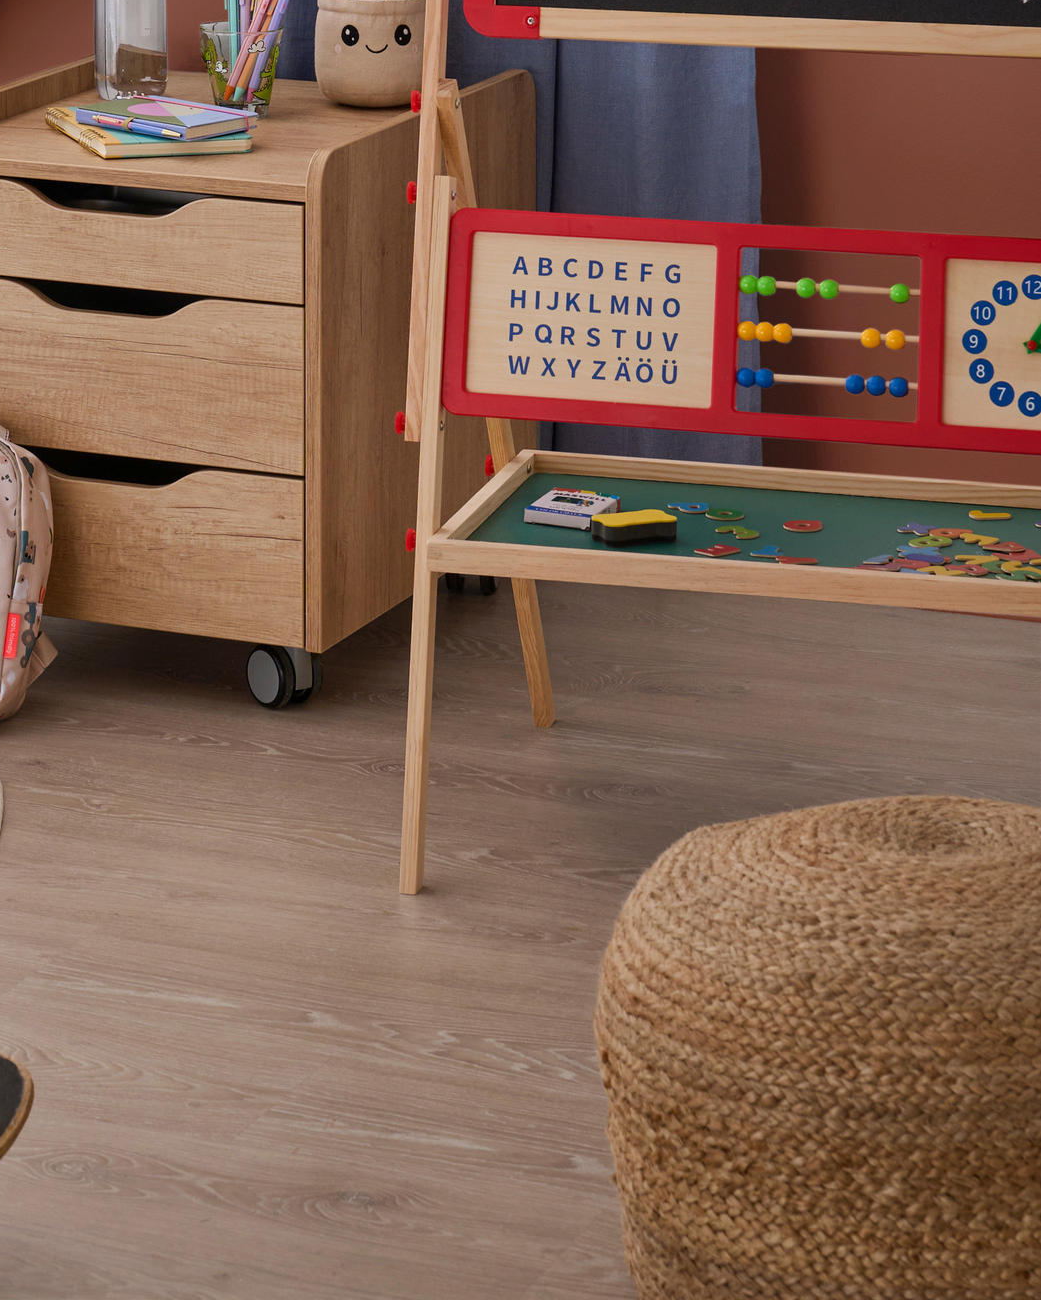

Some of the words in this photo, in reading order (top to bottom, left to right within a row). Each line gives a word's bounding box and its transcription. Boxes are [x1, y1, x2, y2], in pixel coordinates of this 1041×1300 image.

[996, 286, 1013, 300] 11
[1024, 280, 1041, 294] 12
[973, 306, 991, 320] 10
[969, 334, 979, 349] 9
[975, 364, 985, 378] 8
[996, 386, 1006, 401] 7
[1025, 397, 1035, 411] 6
